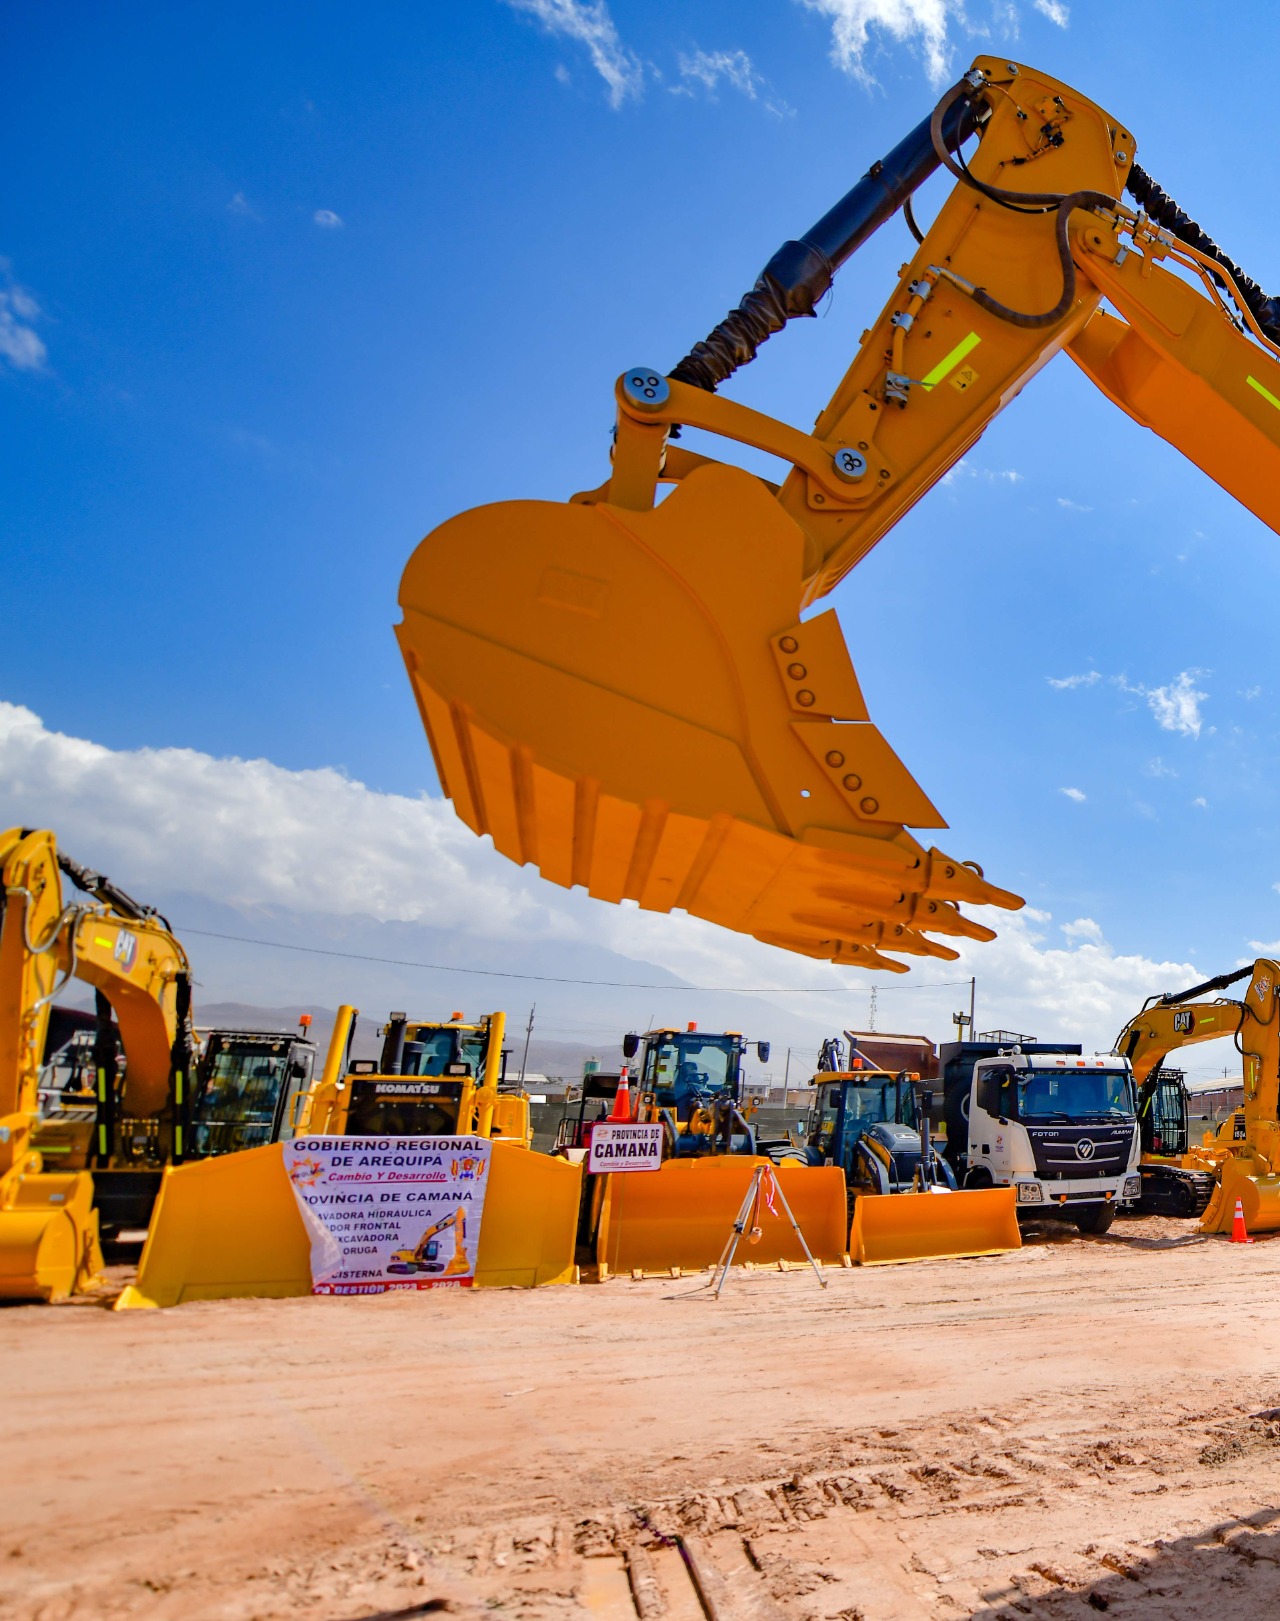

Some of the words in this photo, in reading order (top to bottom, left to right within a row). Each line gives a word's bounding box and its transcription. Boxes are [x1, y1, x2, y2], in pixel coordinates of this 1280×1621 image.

[115, 929, 135, 963] CAT
[1174, 1011, 1191, 1031] CAT
[375, 1083, 439, 1093] KOMATSU
[612, 1129, 648, 1139] PROVINCIA
[651, 1129, 660, 1138] DE
[294, 1140, 390, 1151] GOBIERNO
[396, 1140, 484, 1151] REGIONAL
[595, 1139, 658, 1158] CAMANÁ
[331, 1156, 354, 1167] DE
[359, 1155, 443, 1166] AREQUIPA
[328, 1172, 372, 1182] Cambio
[377, 1172, 386, 1181] Y
[387, 1171, 446, 1181] Desarrollo
[380, 1193, 401, 1203] DE
[406, 1191, 473, 1201] CAMANÁ
[354, 1222, 401, 1231] FRONTAL
[343, 1246, 378, 1255] ORUGA
